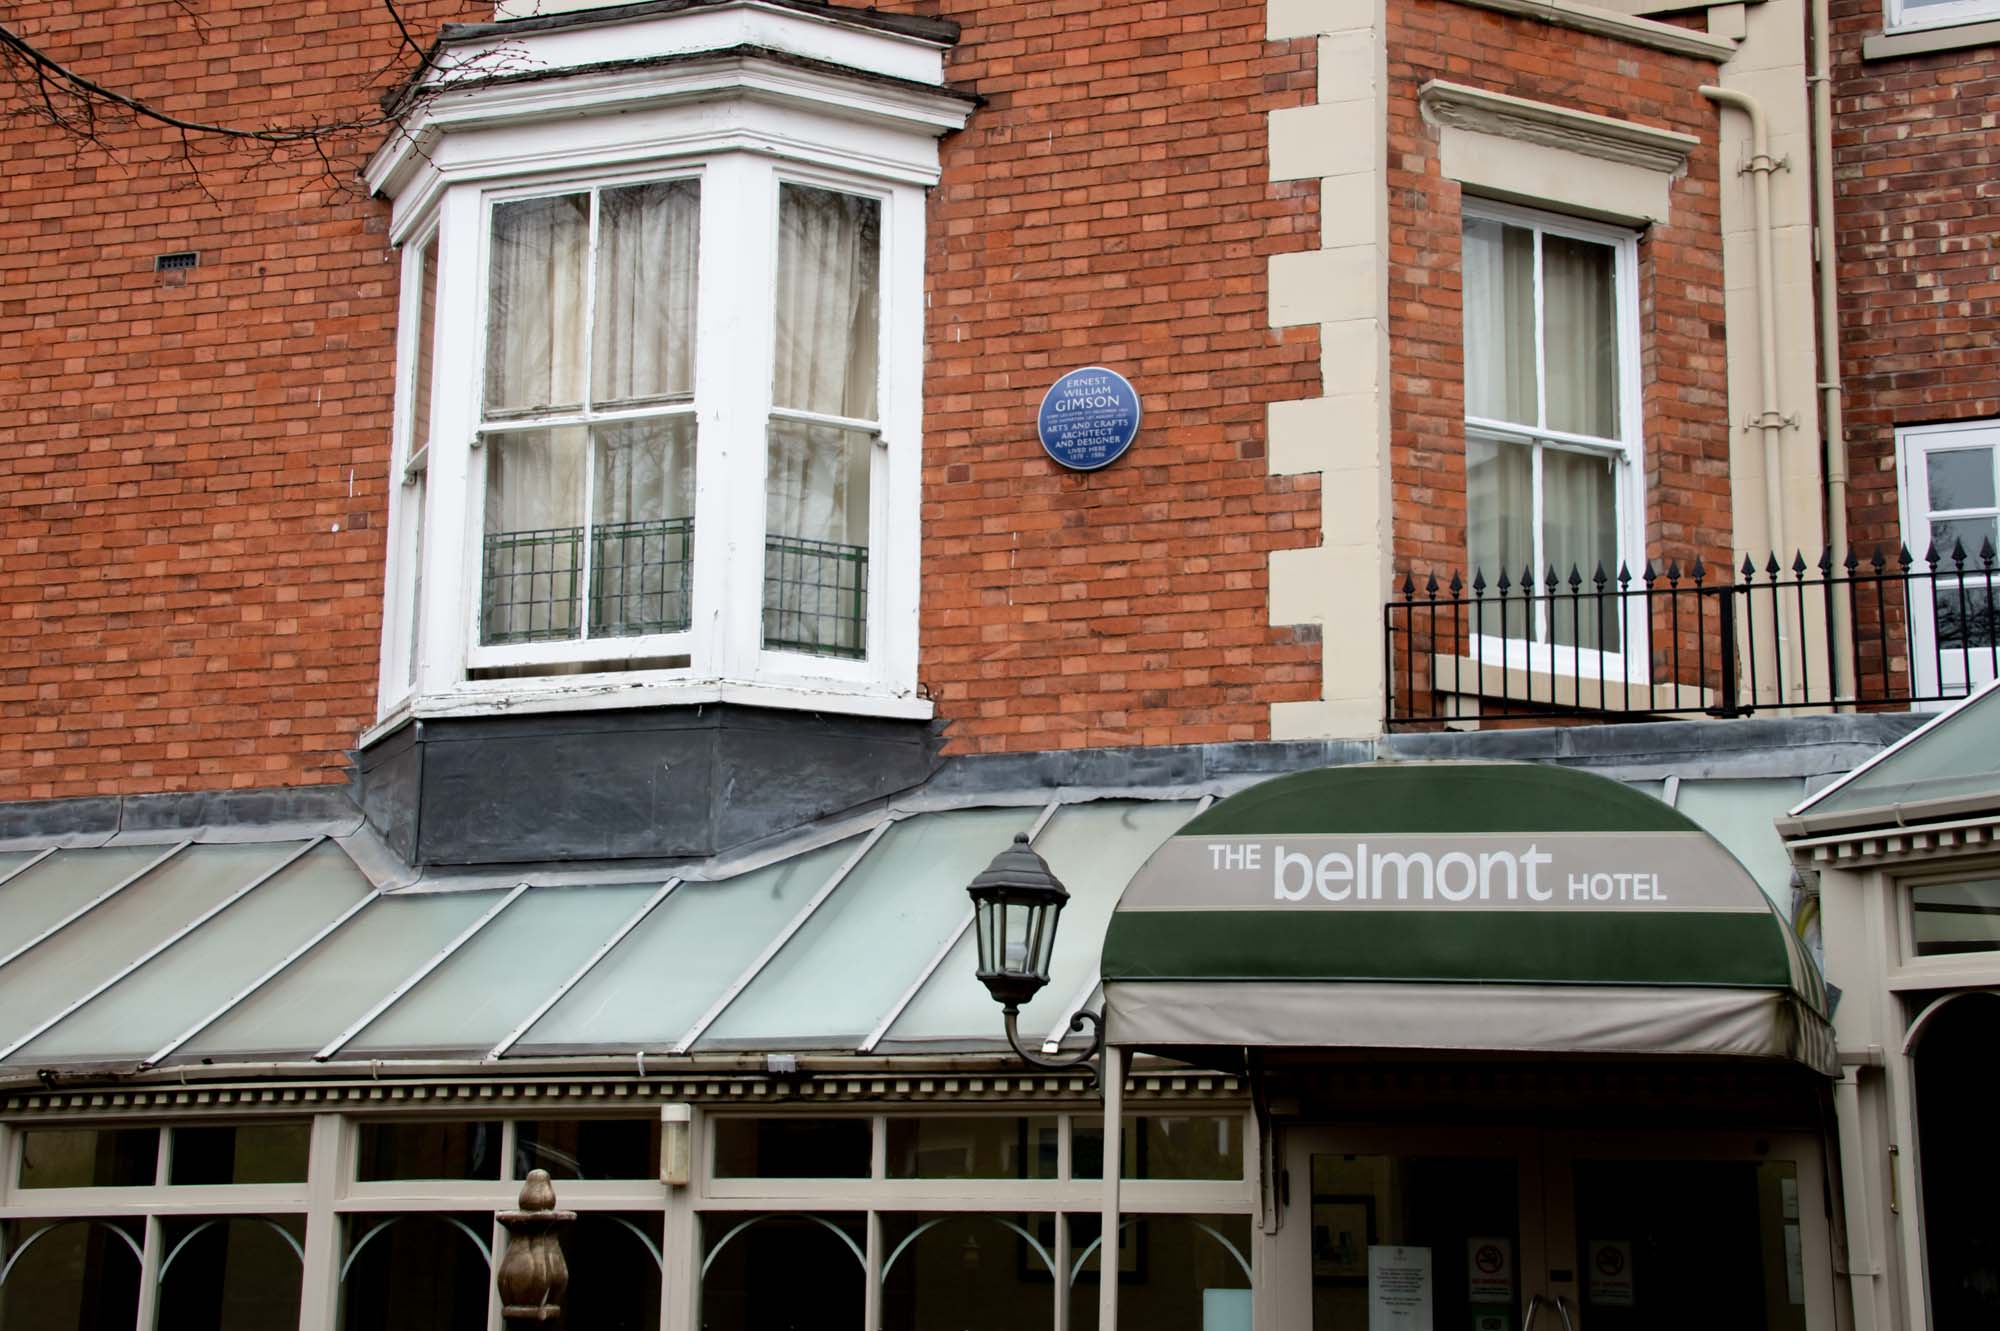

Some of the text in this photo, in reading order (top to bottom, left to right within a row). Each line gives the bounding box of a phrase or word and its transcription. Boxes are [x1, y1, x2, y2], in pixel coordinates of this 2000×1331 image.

[1066, 376, 1107, 387] ERNEST
[1064, 385, 1111, 397] WILLIAM
[1055, 395, 1119, 412] GIMSON
[1047, 424, 1068, 433] ARTS
[1071, 421, 1090, 430] AND
[1093, 419, 1129, 428] CRAFTS
[1061, 427, 1113, 439] ARCHITECT
[1055, 436, 1121, 449] AND DESIGNER
[1067, 446, 1086, 454] LIVED
[1207, 843, 1668, 902] THE belmont HOTEL
